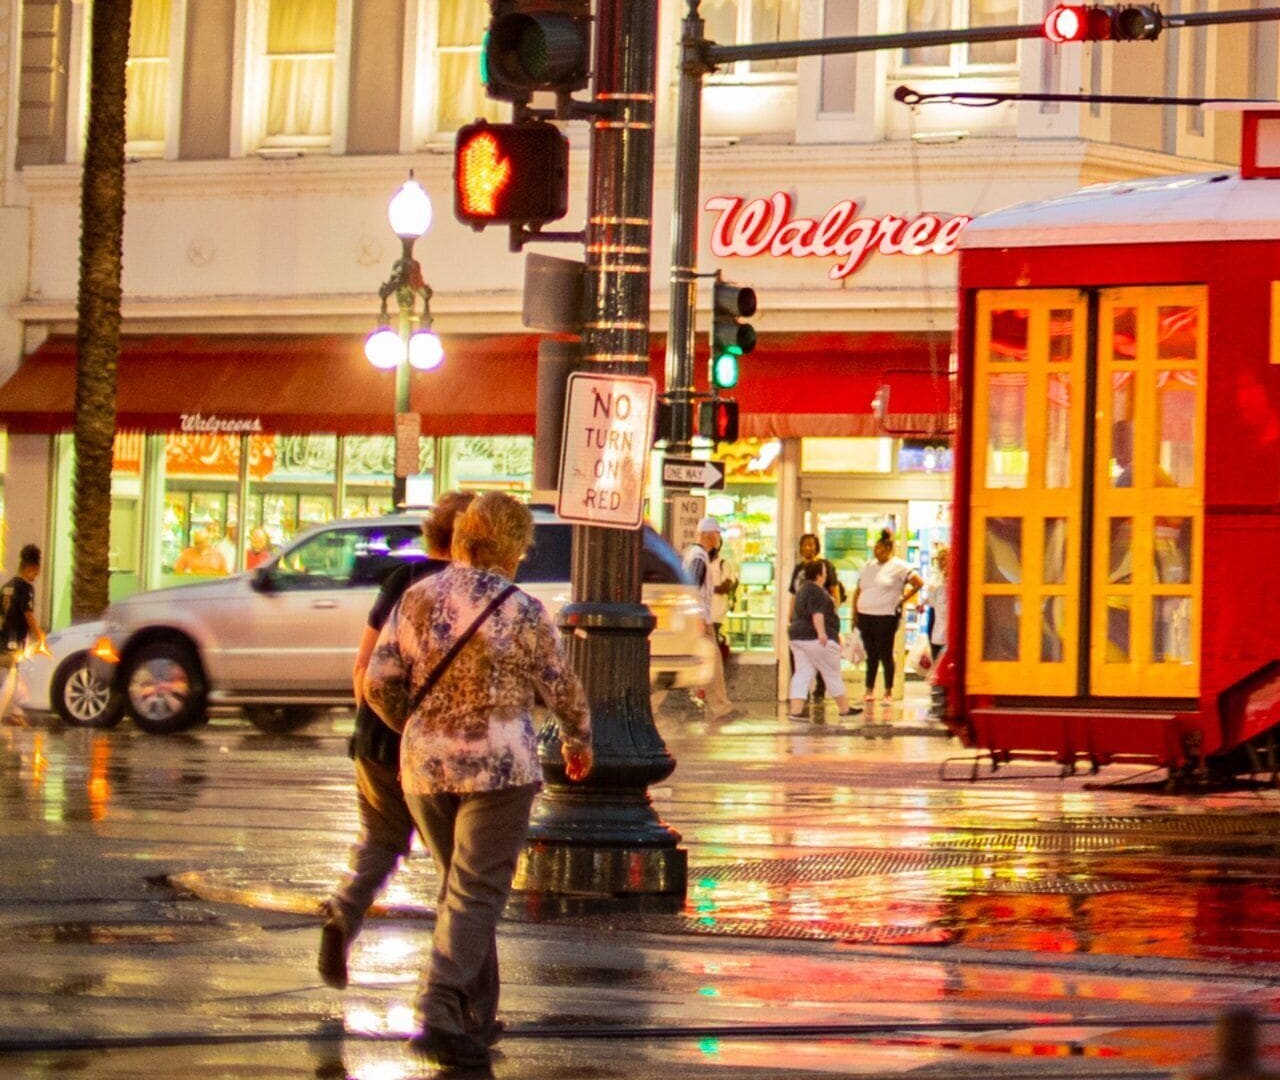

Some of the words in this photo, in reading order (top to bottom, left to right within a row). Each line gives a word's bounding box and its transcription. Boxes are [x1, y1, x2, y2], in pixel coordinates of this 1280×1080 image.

[704, 191, 972, 280] Walgree
[591, 392, 632, 421] NO
[180, 414, 263, 433] Walgreens
[584, 428, 634, 451] TURN
[593, 459, 619, 479] ON
[666, 466, 682, 479] ONE
[685, 468, 704, 479] WAY
[585, 488, 622, 511] RED
[681, 502, 698, 513] NO
